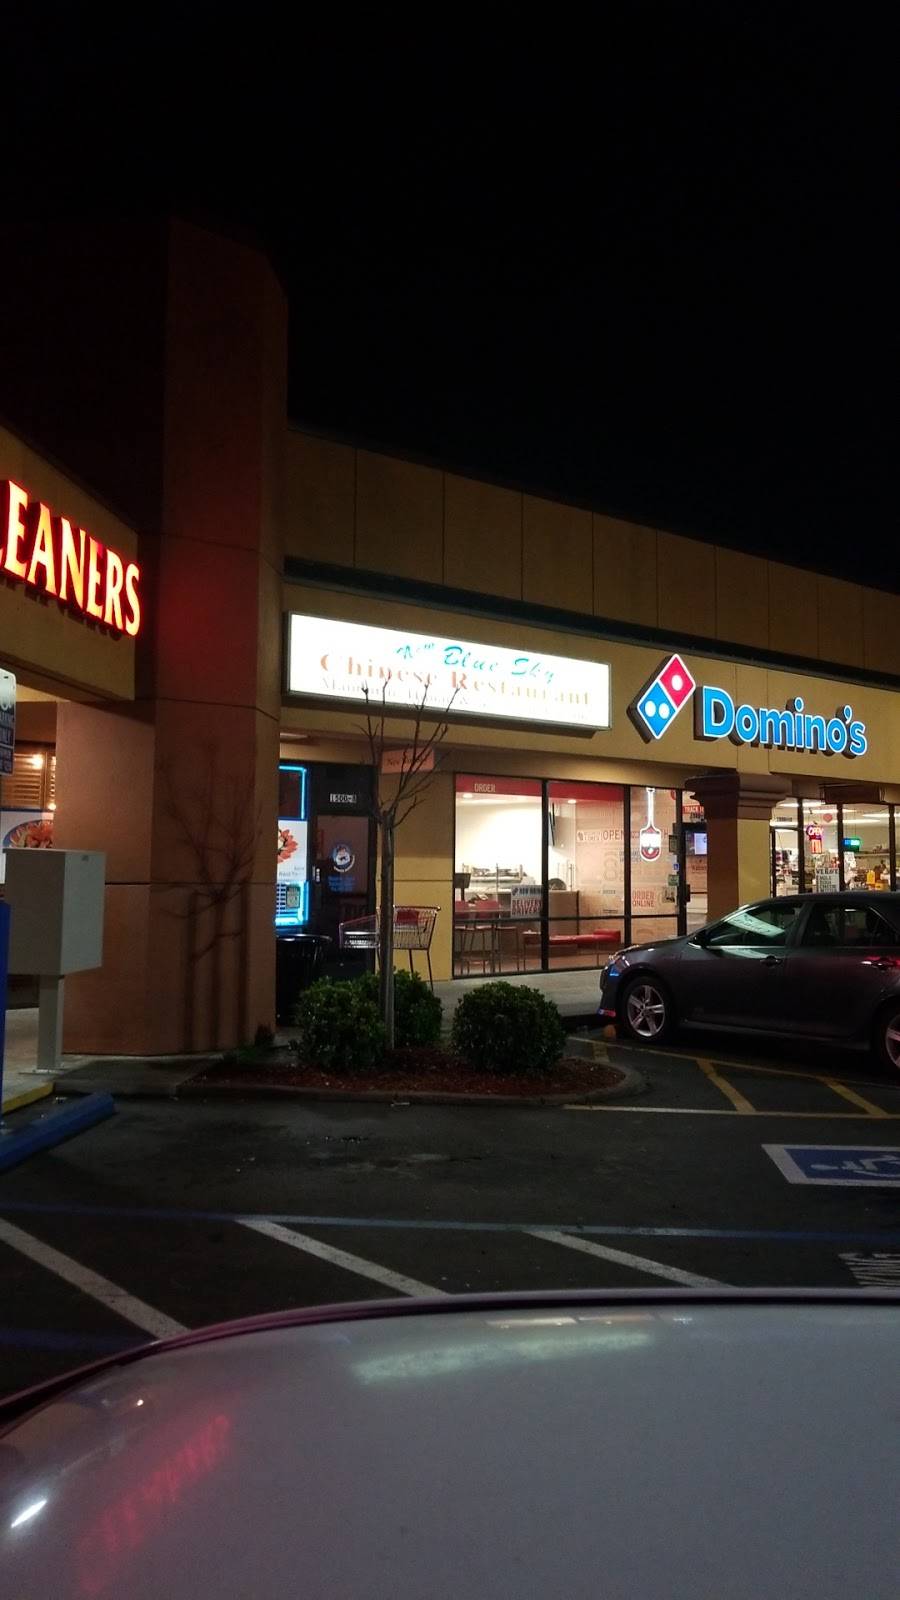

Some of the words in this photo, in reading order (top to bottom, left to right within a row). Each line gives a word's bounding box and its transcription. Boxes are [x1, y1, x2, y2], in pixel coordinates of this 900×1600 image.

[0, 480, 141, 637] EANERS
[319, 653, 440, 687] Chinese
[450, 670, 592, 706] Restaurant
[443, 644, 499, 673] Blue
[510, 656, 556, 685] Sky
[702, 684, 868, 756] Domino's
[474, 783, 496, 793] ORDER
[632, 891, 655, 900] ORDER
[632, 900, 655, 909] ONLINE
